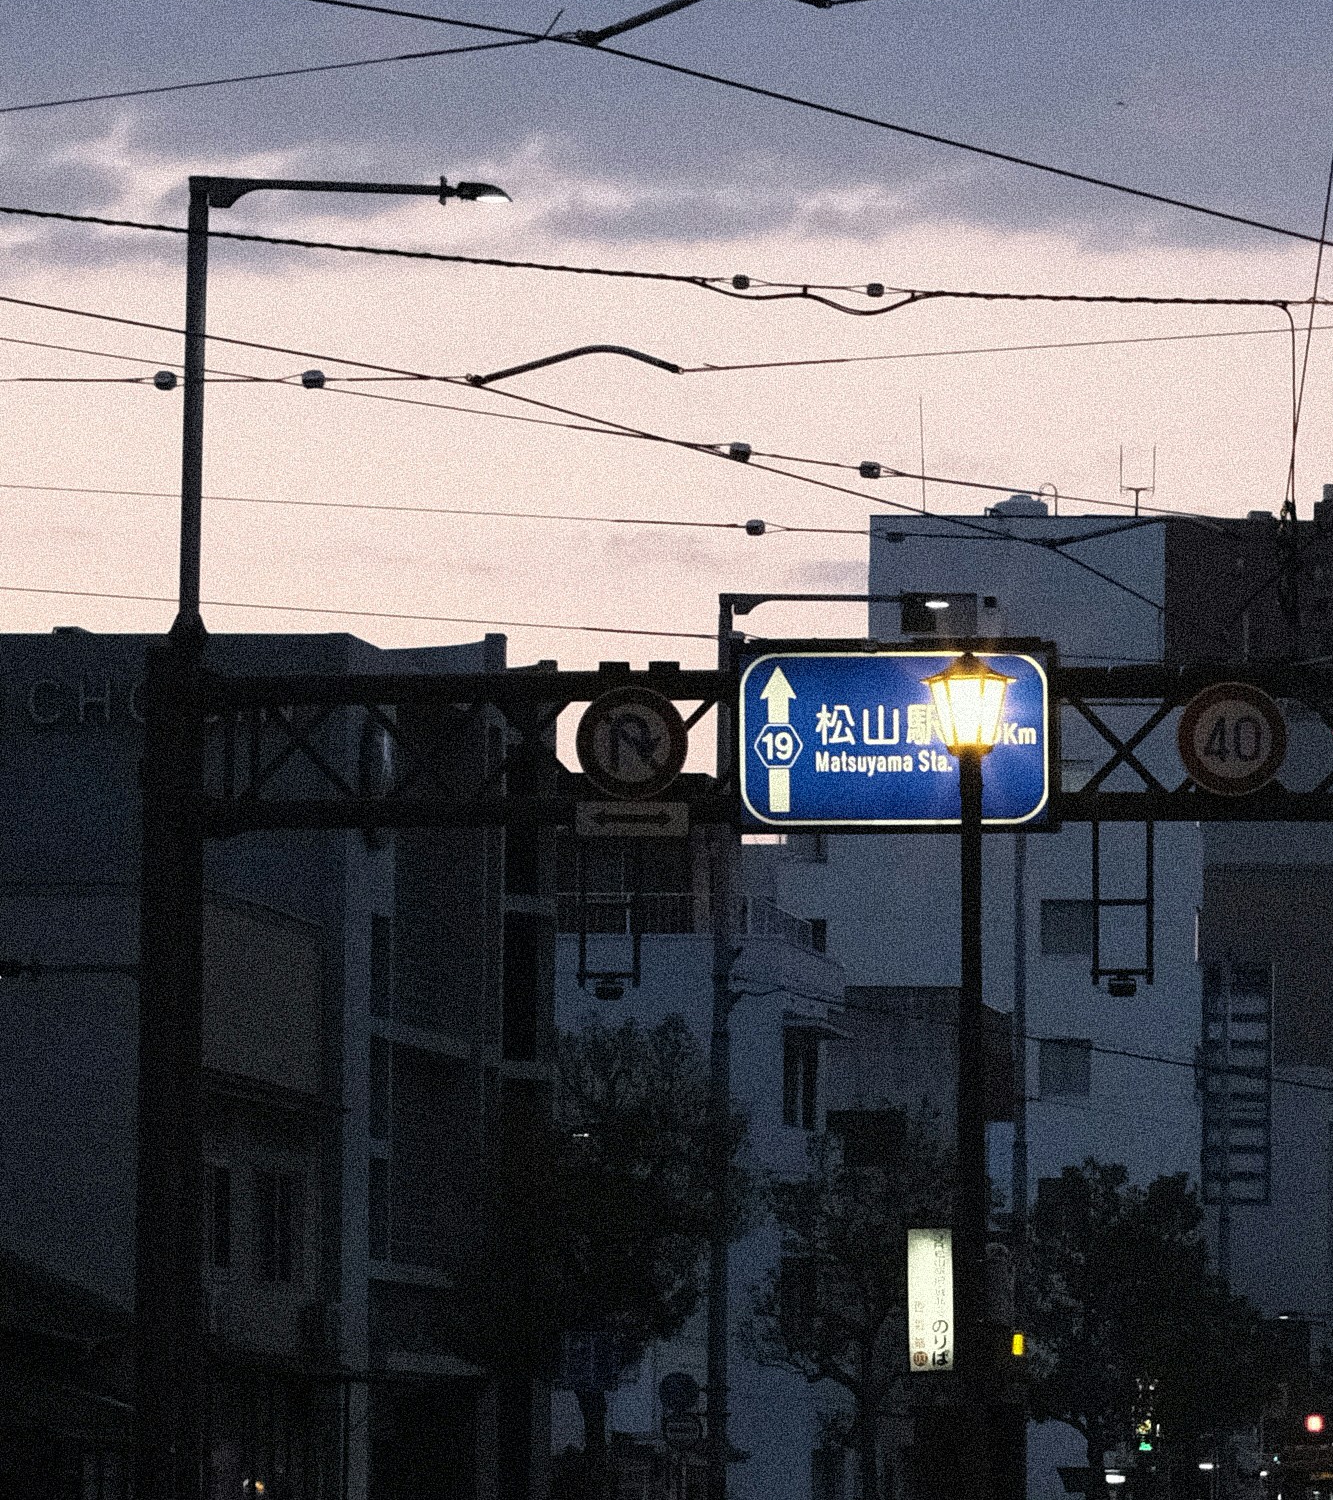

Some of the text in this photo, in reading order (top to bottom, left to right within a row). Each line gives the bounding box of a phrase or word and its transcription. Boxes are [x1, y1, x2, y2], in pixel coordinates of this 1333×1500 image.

[761, 731, 793, 760] 19
[815, 703, 944, 746] 松山駅
[1204, 716, 1261, 761] 40
[815, 749, 953, 777] Matsuyama Sta.
[931, 1319, 949, 1367] のりば
